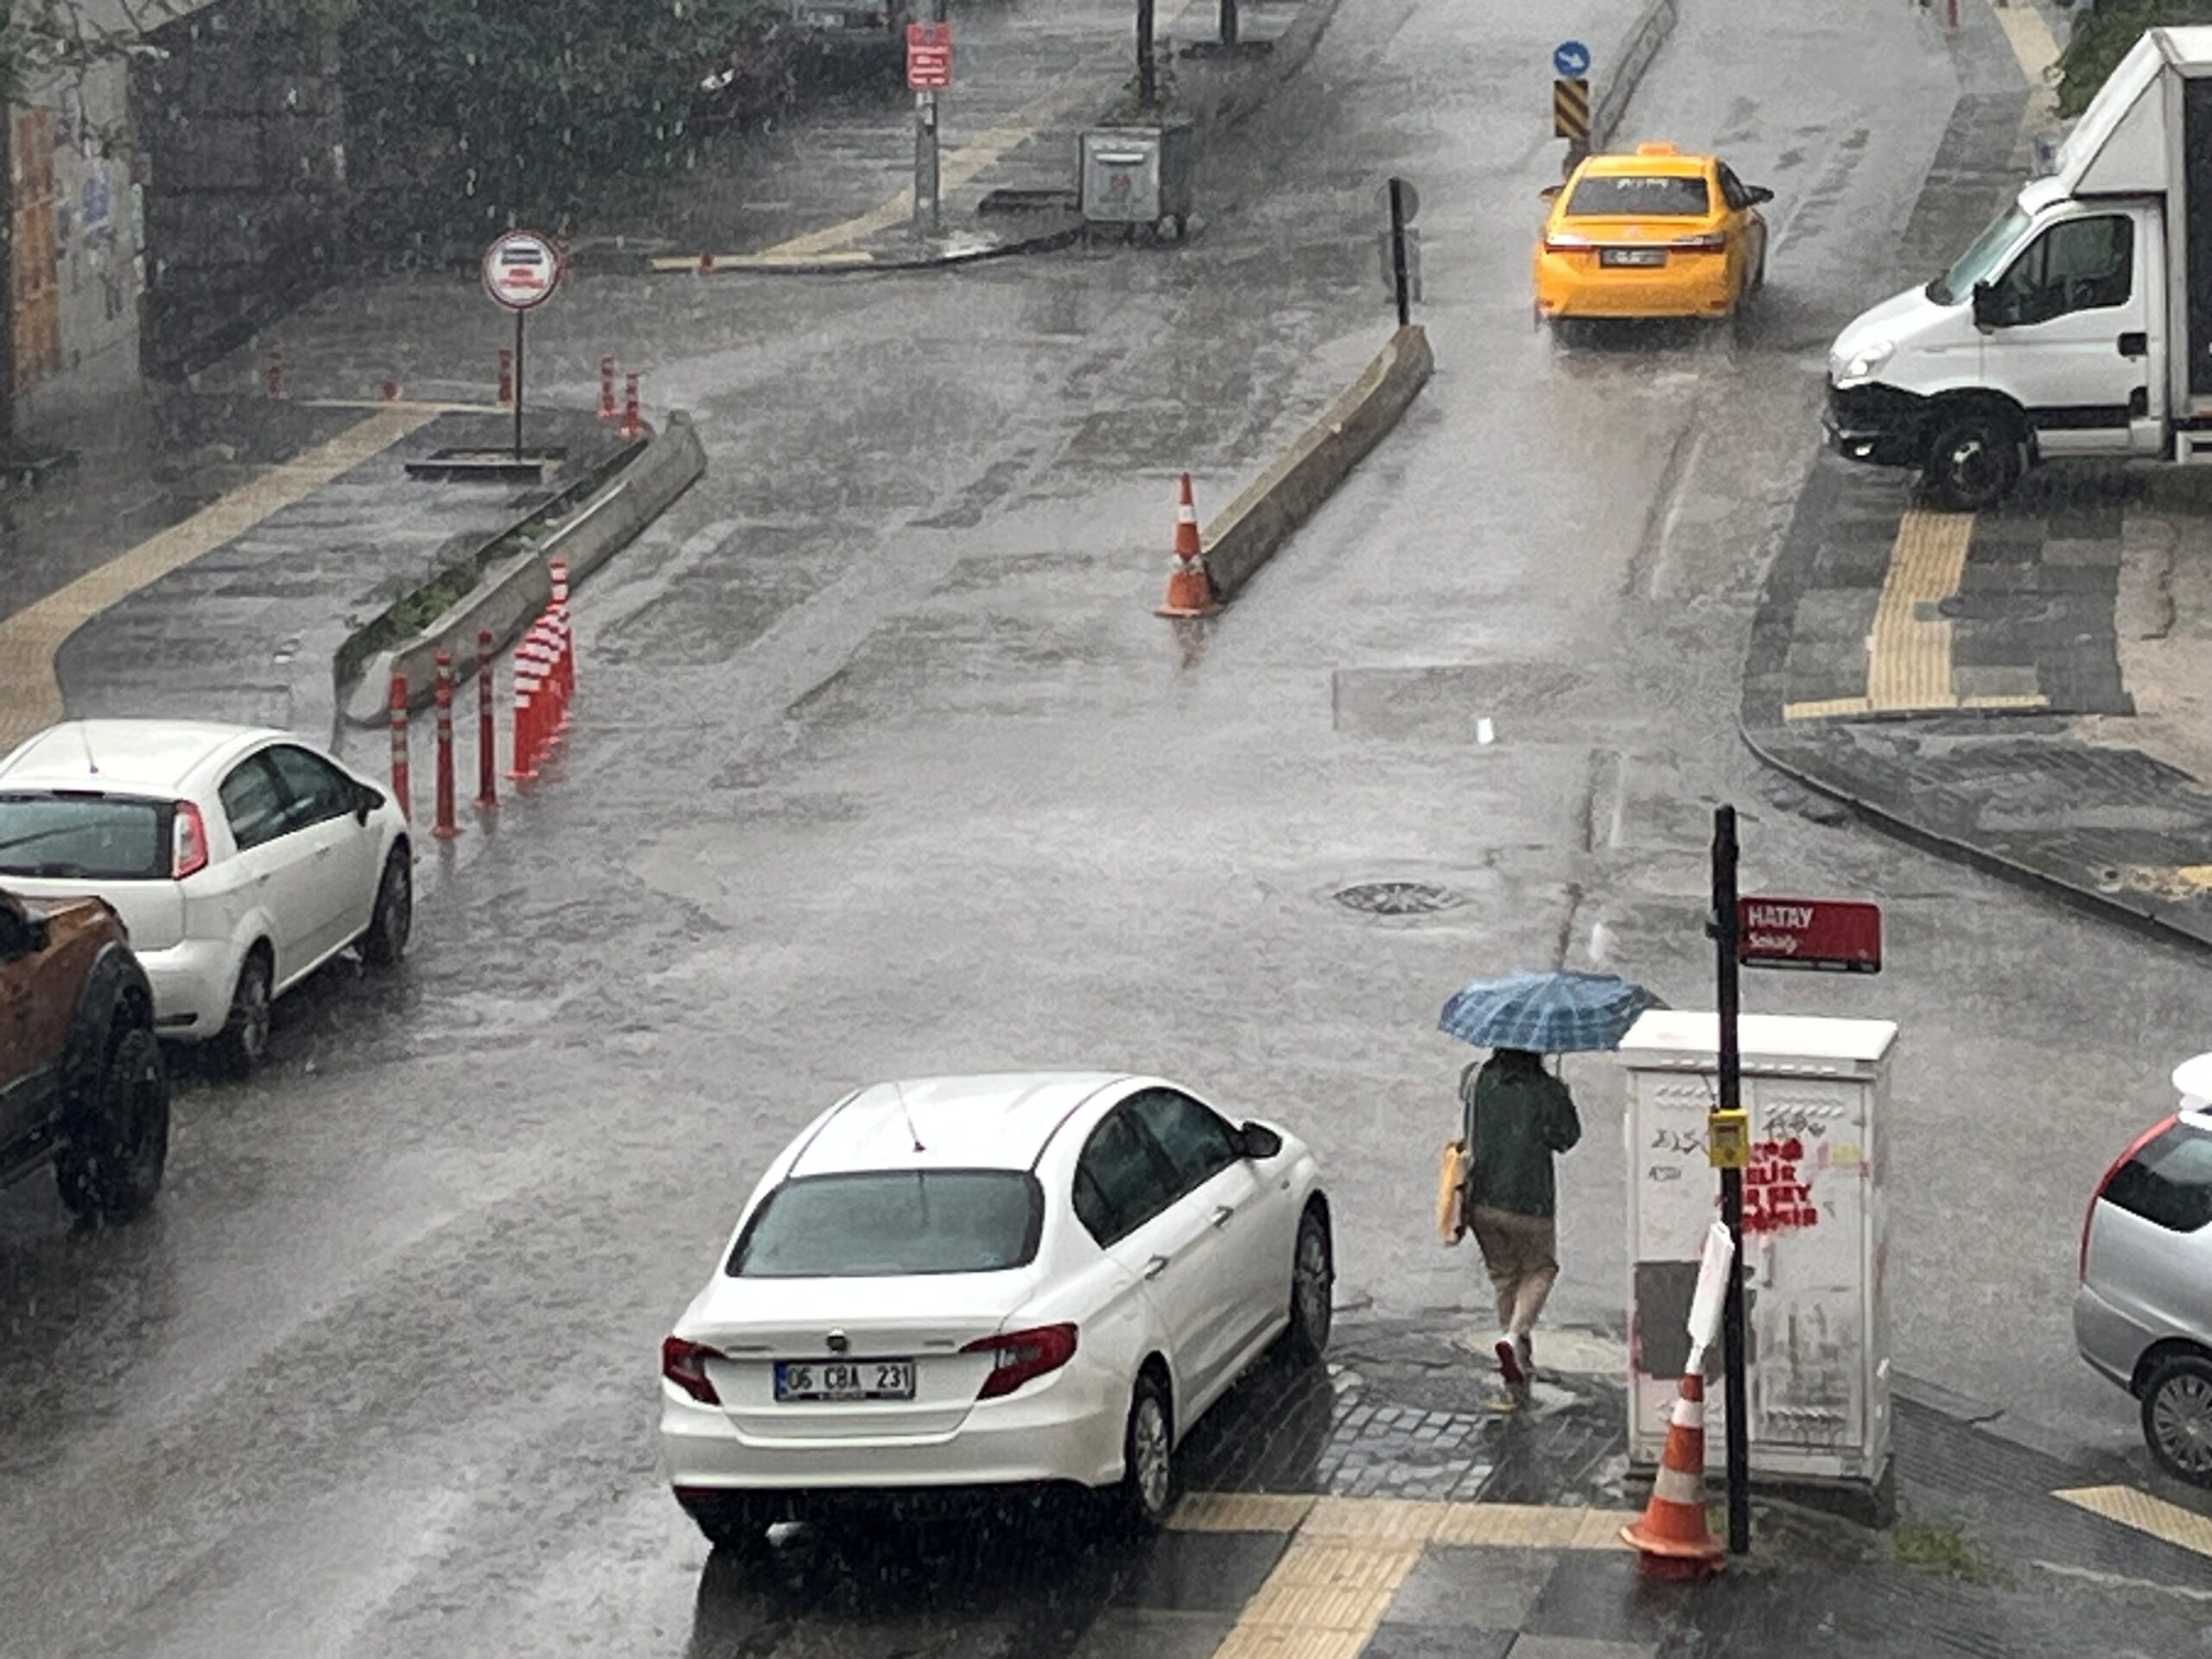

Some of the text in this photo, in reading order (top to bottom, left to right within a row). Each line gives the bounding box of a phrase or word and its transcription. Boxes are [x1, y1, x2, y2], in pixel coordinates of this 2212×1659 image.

[1748, 906, 1814, 929] HATAY
[787, 1364, 909, 1390] 06 CBA 231
